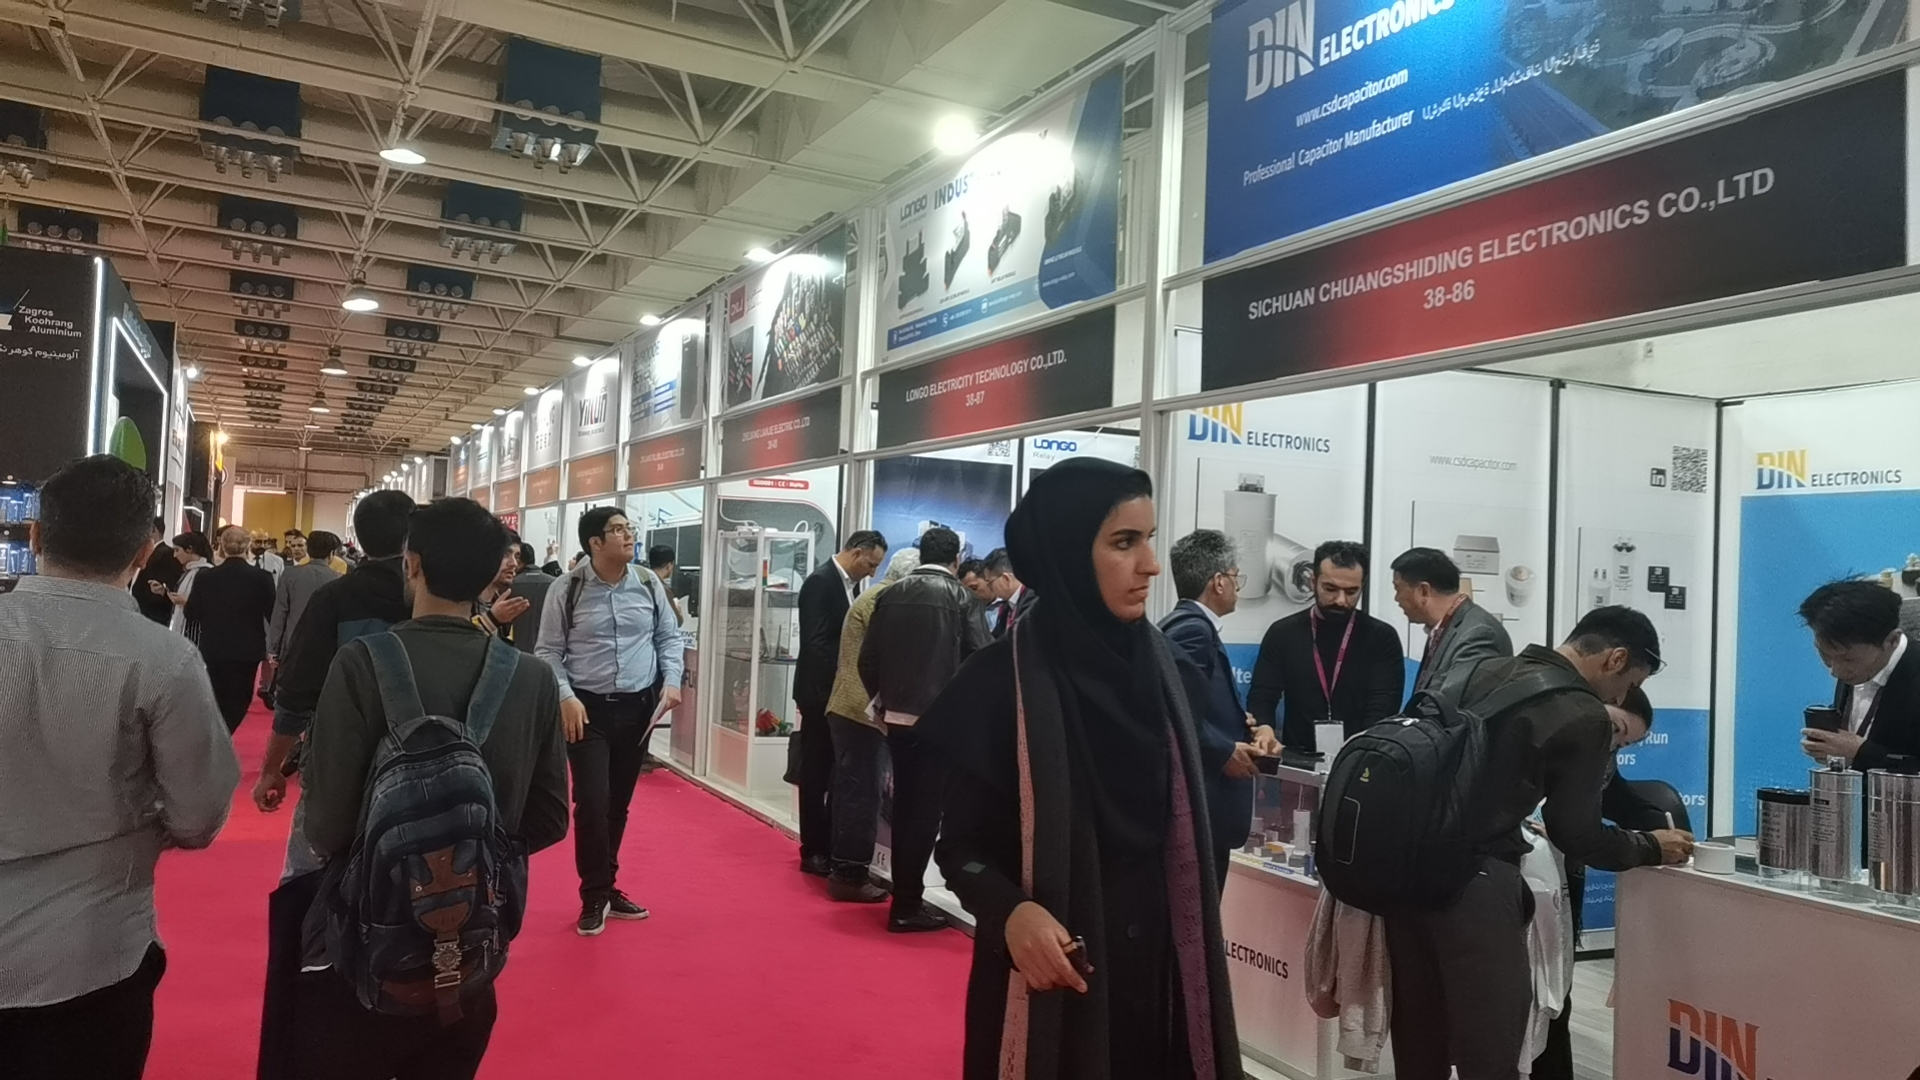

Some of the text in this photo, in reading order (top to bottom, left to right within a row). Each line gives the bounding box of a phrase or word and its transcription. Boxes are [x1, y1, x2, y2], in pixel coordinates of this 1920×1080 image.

[1245, 0, 1455, 102] DIN ELECTRONIC
[1296, 68, 1409, 127] www.csdcapacitor.com
[1243, 109, 1415, 187] Professional Capacitor Manufacturer
[1248, 167, 1775, 320] SICHUAN CHUANGSHIDING ELECTRONICS CO.,LTD
[18, 305, 54, 317] Zagros
[1423, 279, 1476, 310] 38-86
[24, 315, 74, 330] Koohrang
[29, 325, 82, 338] Aluminium
[905, 349, 1067, 403] LONGO ELECTRICITY TECHNOLOGY CO.,LTD.
[965, 390, 985, 407] 38-87
[1188, 401, 1331, 453] DIN ELECTRONICS
[1033, 451, 1056, 462] Relay
[1034, 438, 1077, 453] LONGO
[1756, 449, 1902, 490] DIN ELECTRONICS
[1616, 753, 1637, 766] ors
[1680, 793, 1706, 807] ors
[1225, 939, 1289, 980] LECTRONICS
[1667, 998, 1761, 1080] DIN
